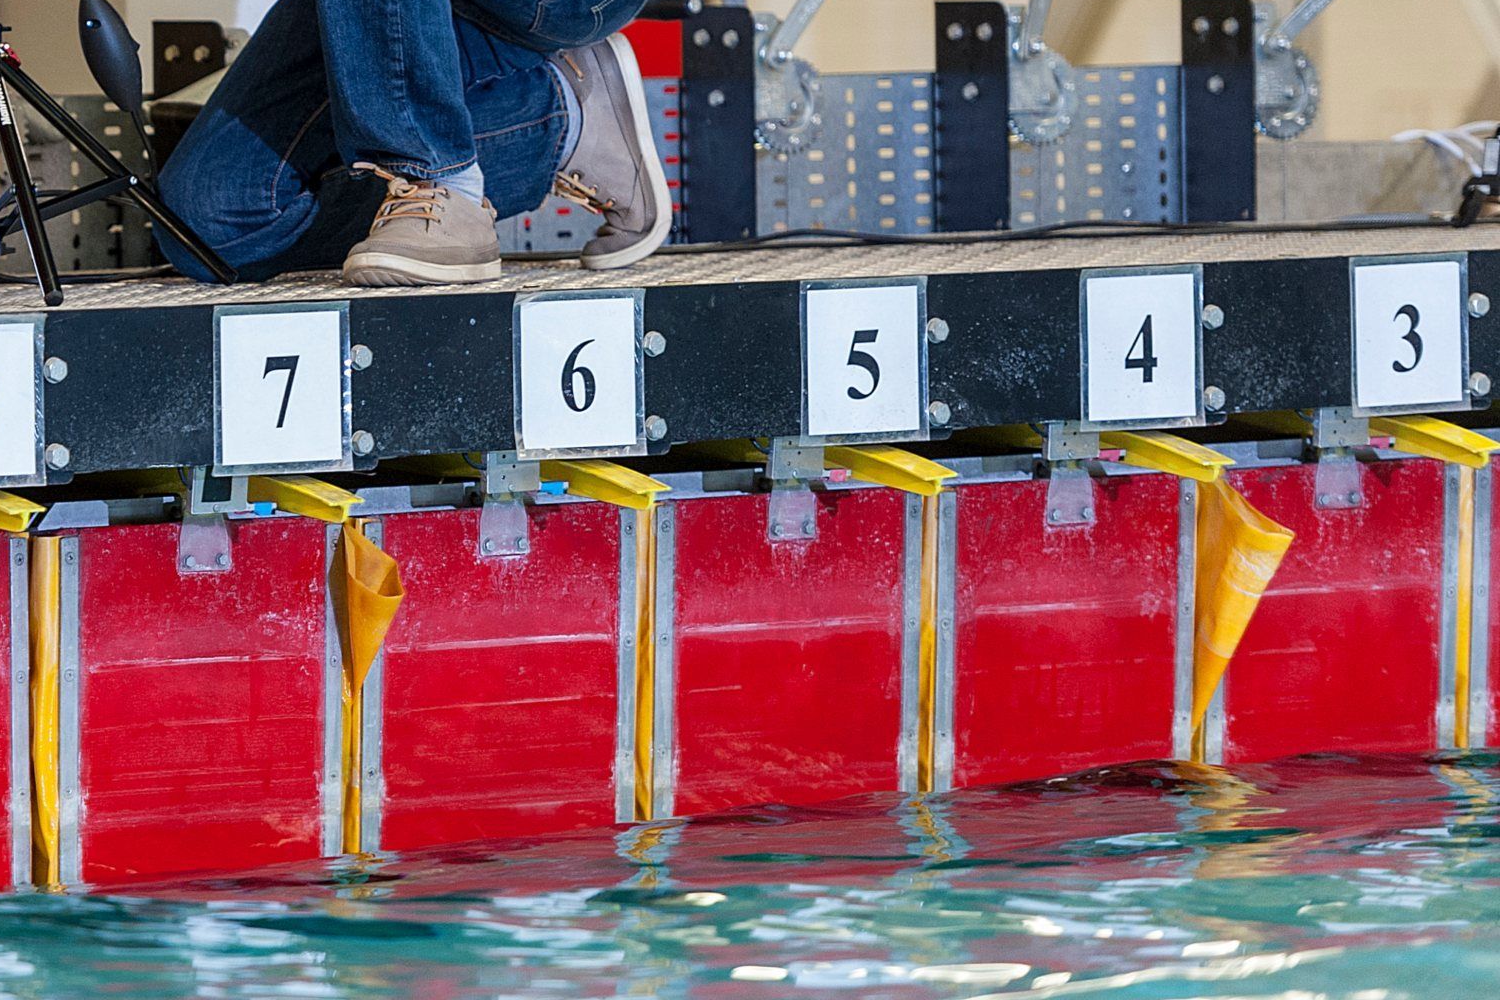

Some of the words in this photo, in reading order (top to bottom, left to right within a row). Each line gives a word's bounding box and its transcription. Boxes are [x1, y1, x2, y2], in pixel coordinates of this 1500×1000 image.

[846, 329, 881, 400] 5
[1124, 314, 1158, 383] 4
[1391, 304, 1424, 373] 3
[262, 354, 300, 429] 7
[560, 338, 596, 413] 6
